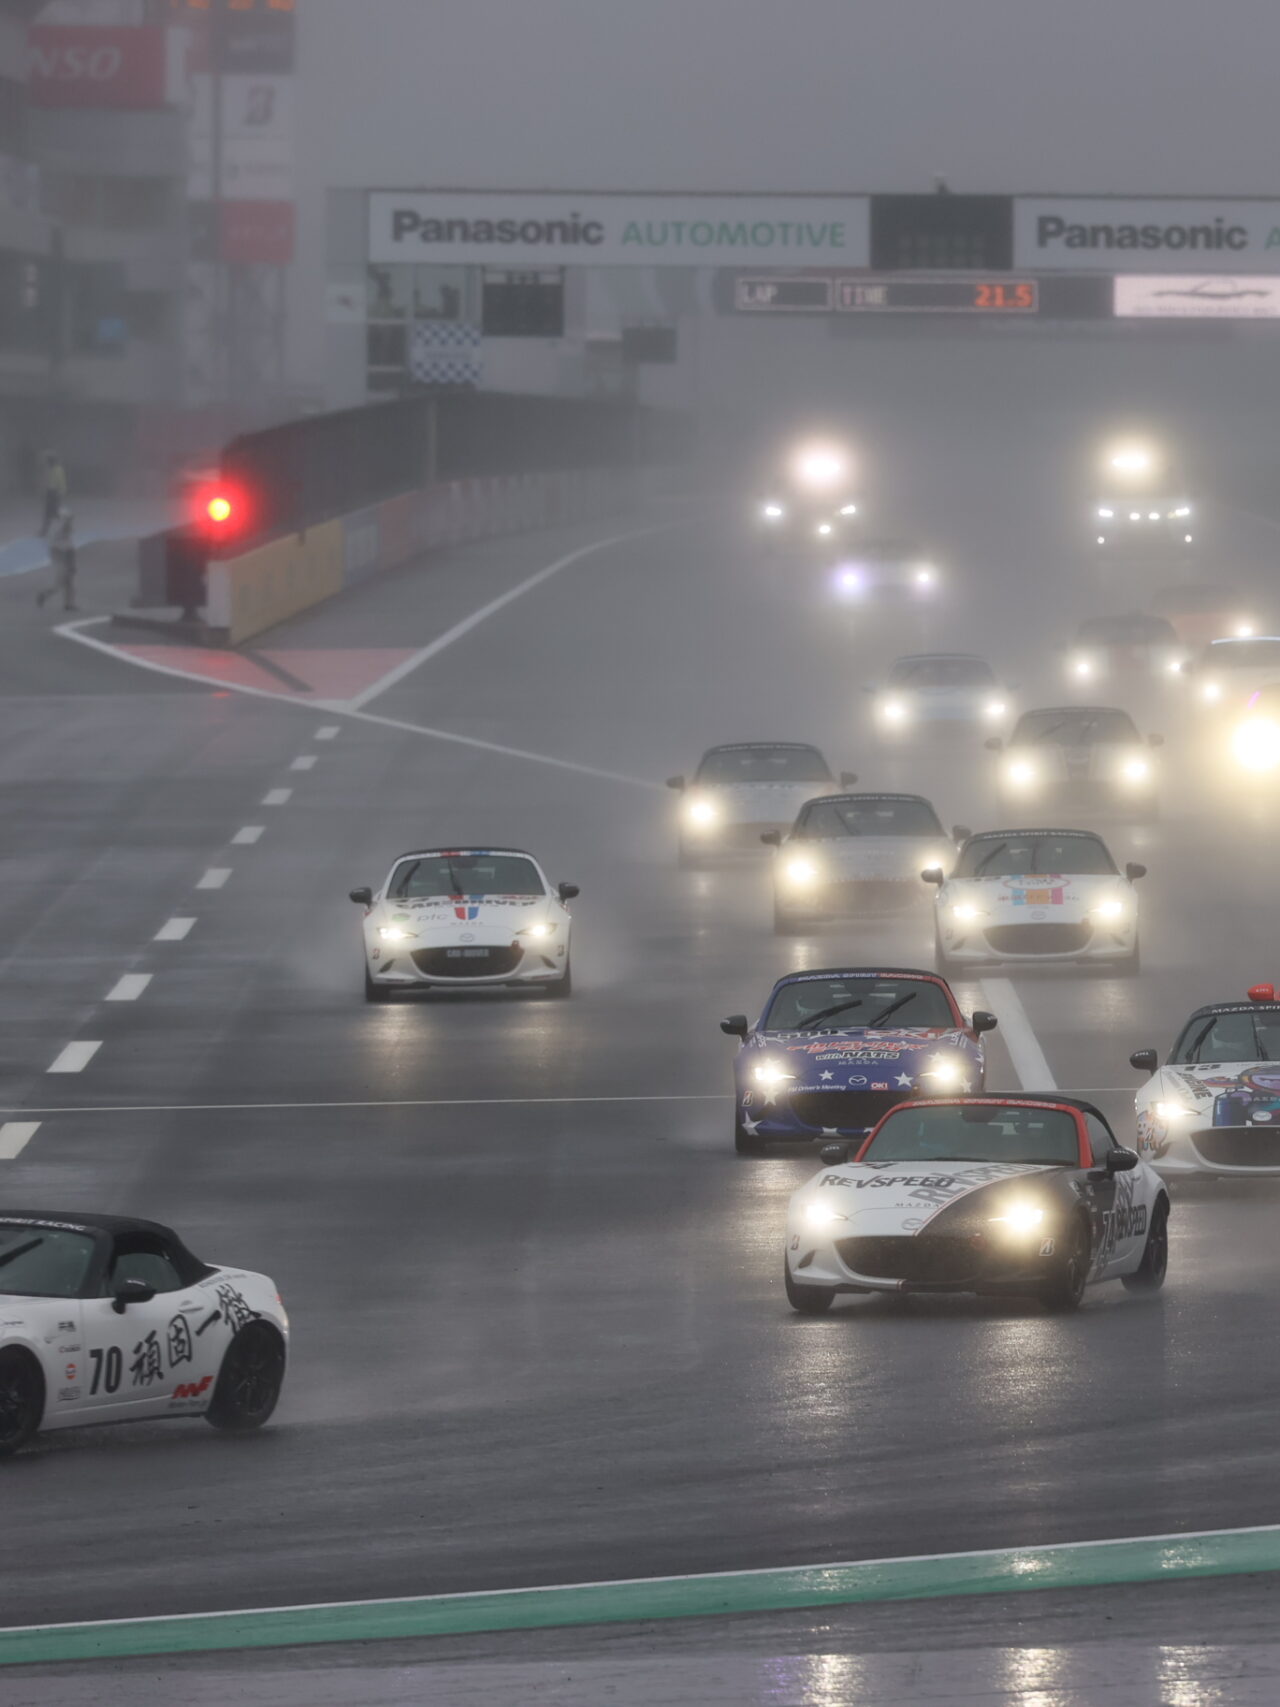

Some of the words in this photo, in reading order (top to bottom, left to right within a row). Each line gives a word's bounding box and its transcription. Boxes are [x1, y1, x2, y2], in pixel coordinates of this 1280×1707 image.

[392, 210, 605, 247] Panasonic
[620, 220, 846, 248] AUTOMOTIVE
[1036, 214, 1249, 251] Panasonic
[974, 284, 1033, 307] 21.5
[1211, 1004, 1255, 1014] MAZDA
[818, 1174, 957, 1190] REVSPEED
[35, 1218, 87, 1232] RACING
[89, 1346, 123, 1396] 70
